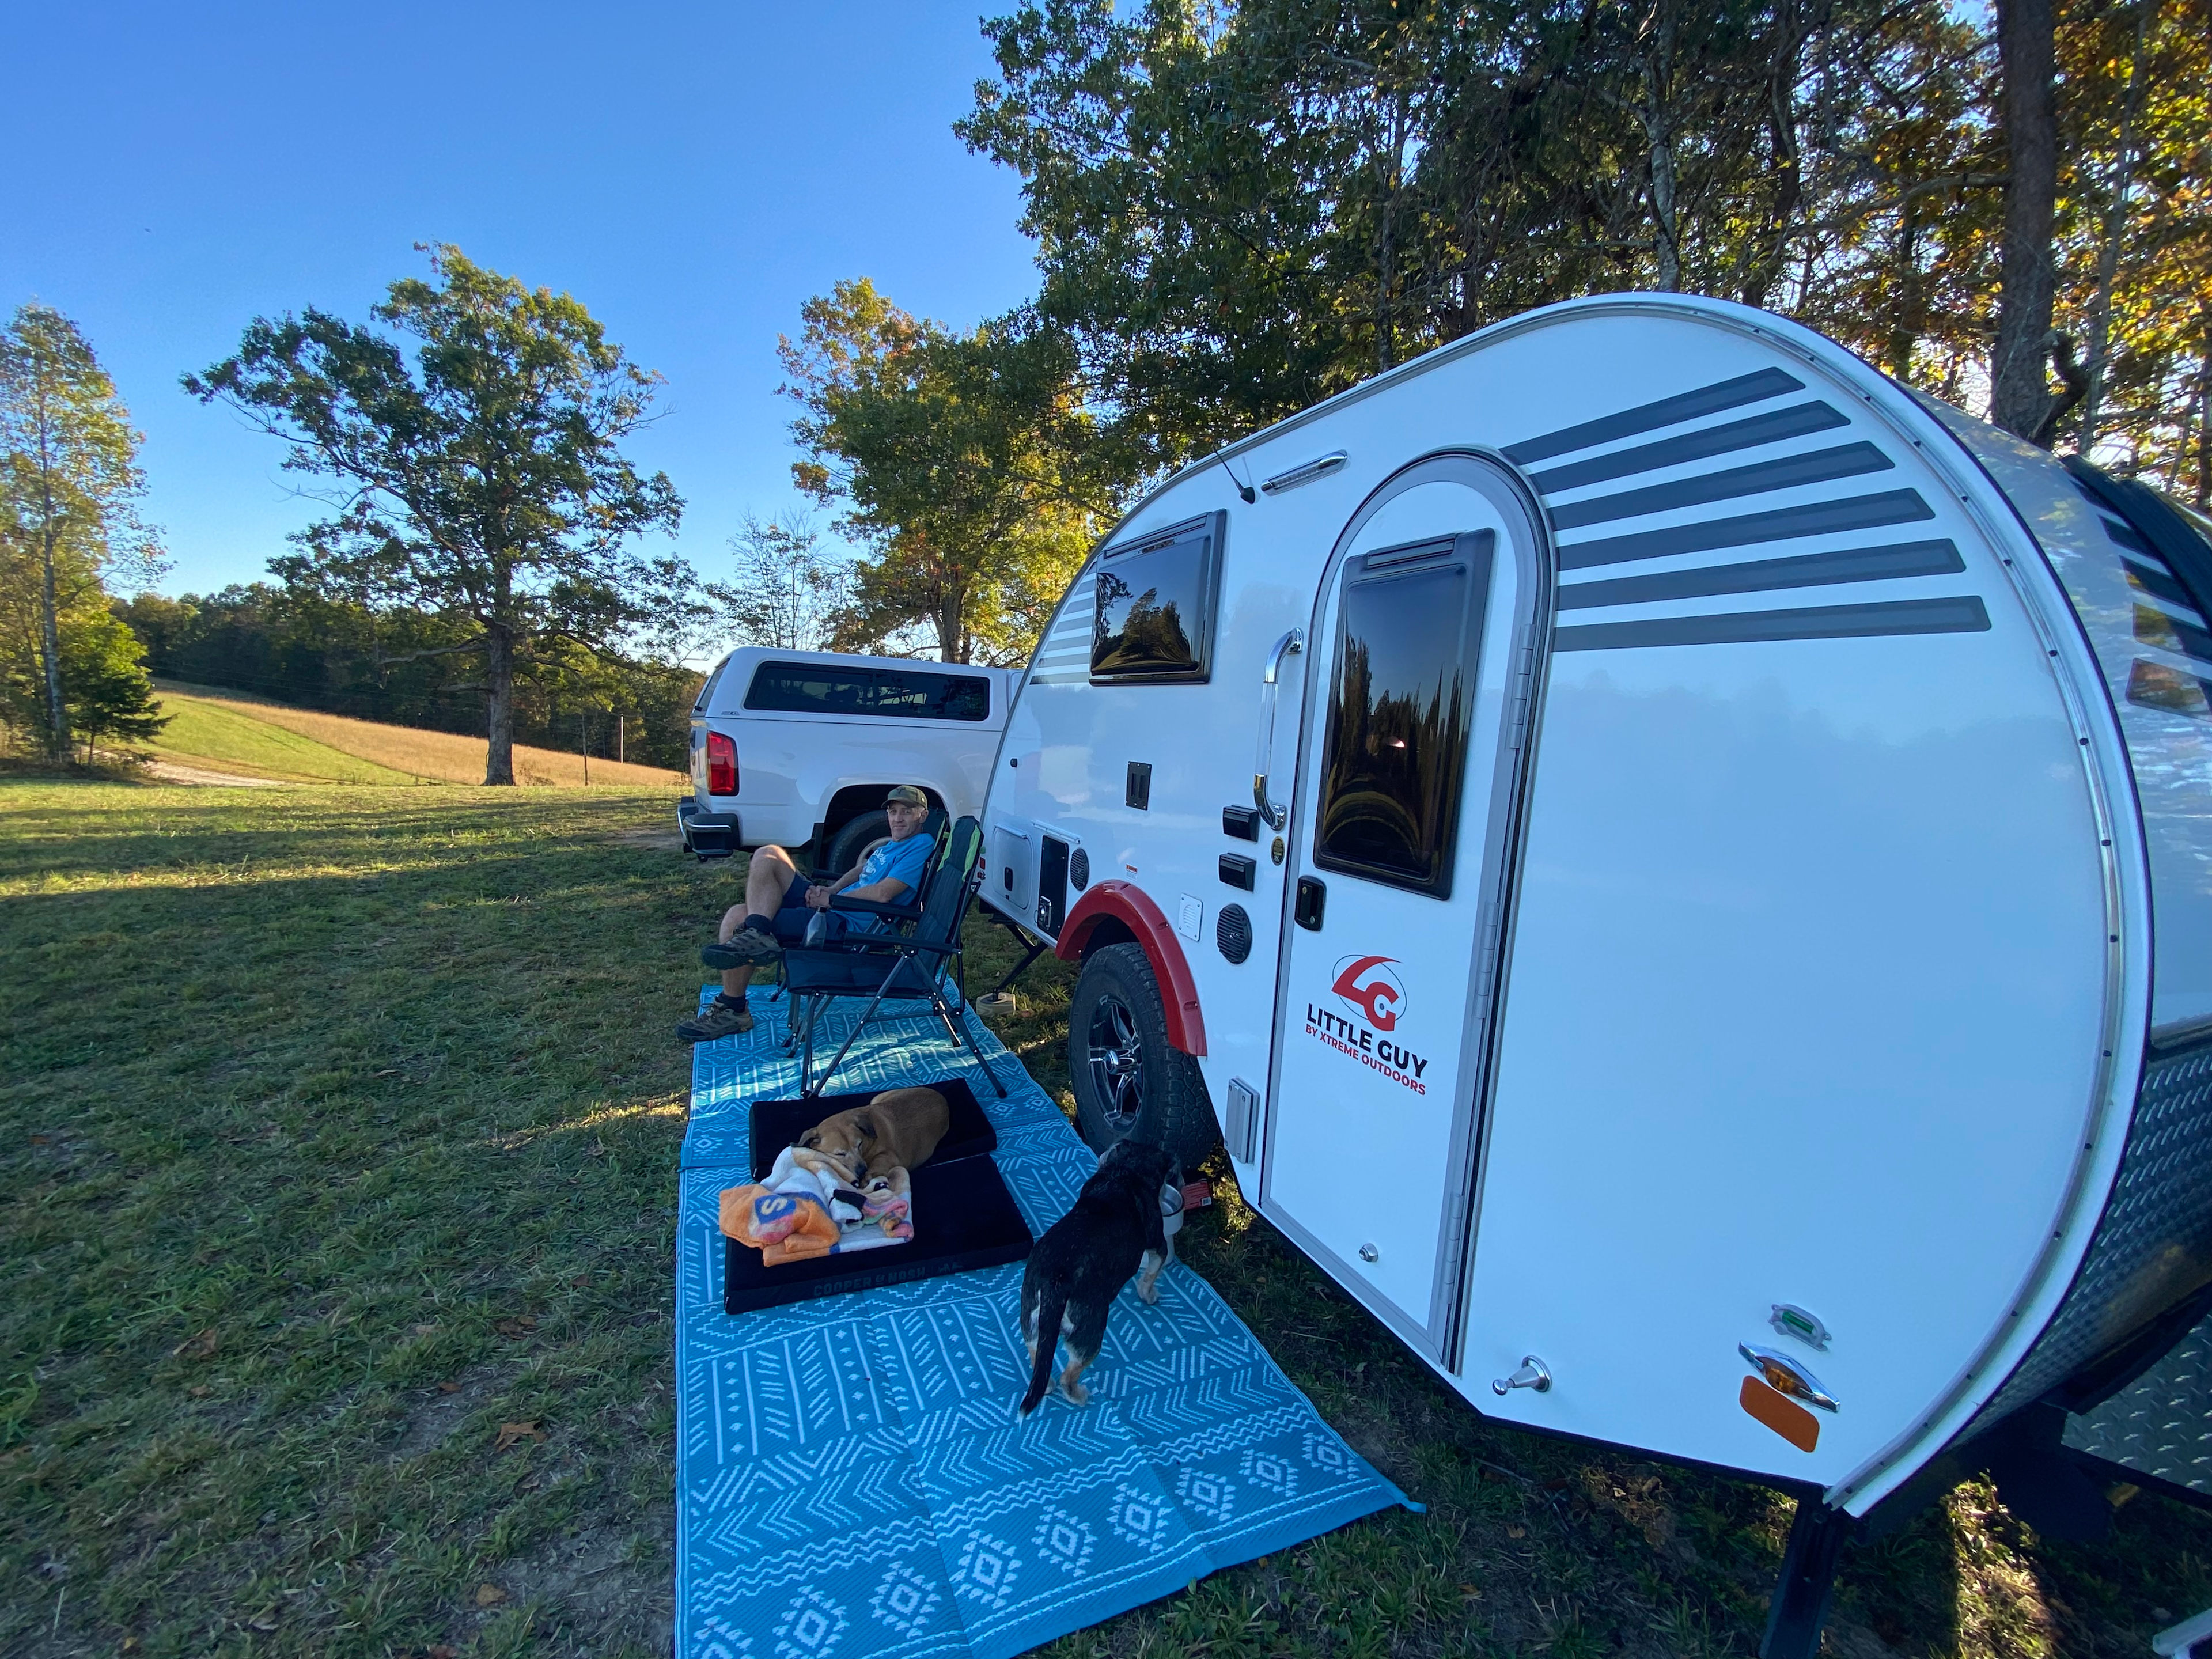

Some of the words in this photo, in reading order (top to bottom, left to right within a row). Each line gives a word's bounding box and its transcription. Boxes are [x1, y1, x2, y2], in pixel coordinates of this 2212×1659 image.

[1305, 1024, 1318, 1037] BY
[1320, 1031, 1359, 1060] XTREME
[1361, 1049, 1426, 1096] OUTDOORS
[1307, 1002, 1373, 1053] LITTLE
[1377, 1040, 1429, 1079] GUY
[813, 1277, 872, 1296] COOPER
[888, 1267, 925, 1284] NASH
